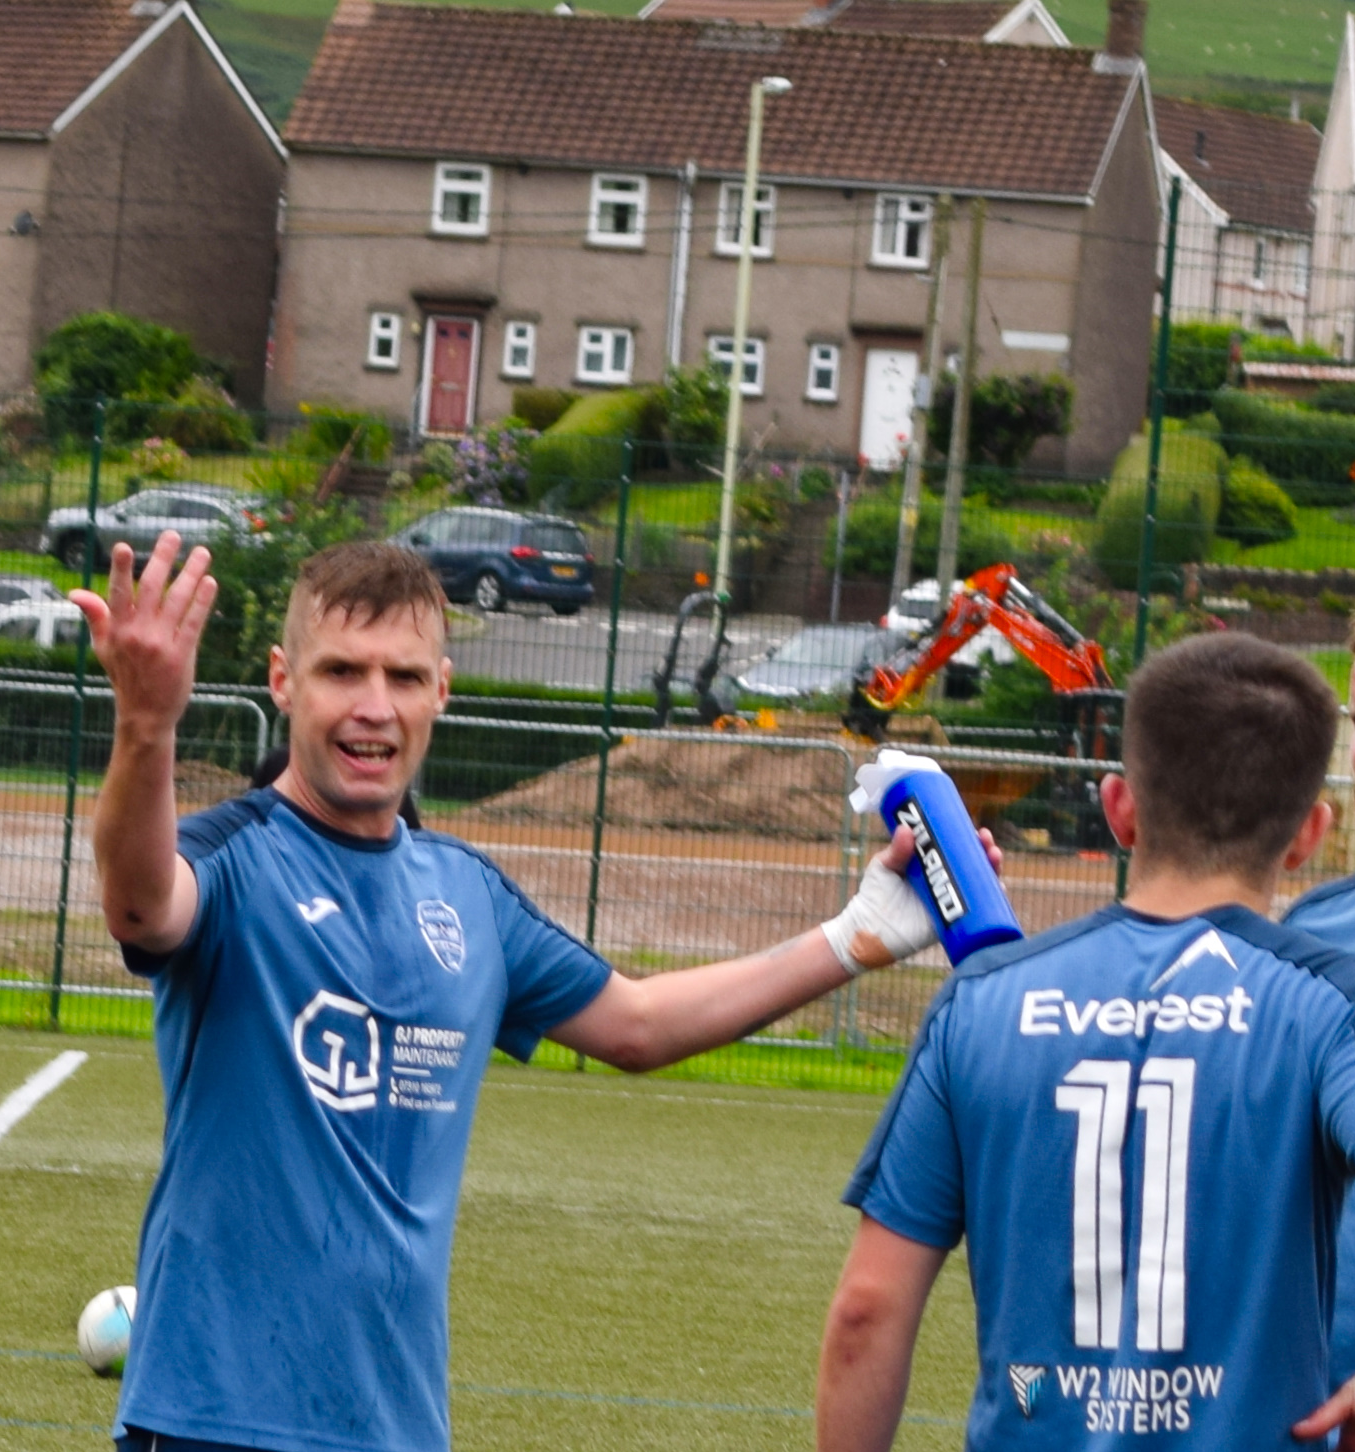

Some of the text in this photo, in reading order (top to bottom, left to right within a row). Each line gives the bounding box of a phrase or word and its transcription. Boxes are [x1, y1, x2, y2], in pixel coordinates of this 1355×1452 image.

[1019, 986, 1253, 1038] Everest
[1056, 1057, 1197, 1352] 11
[1056, 1365, 1101, 1398] W2
